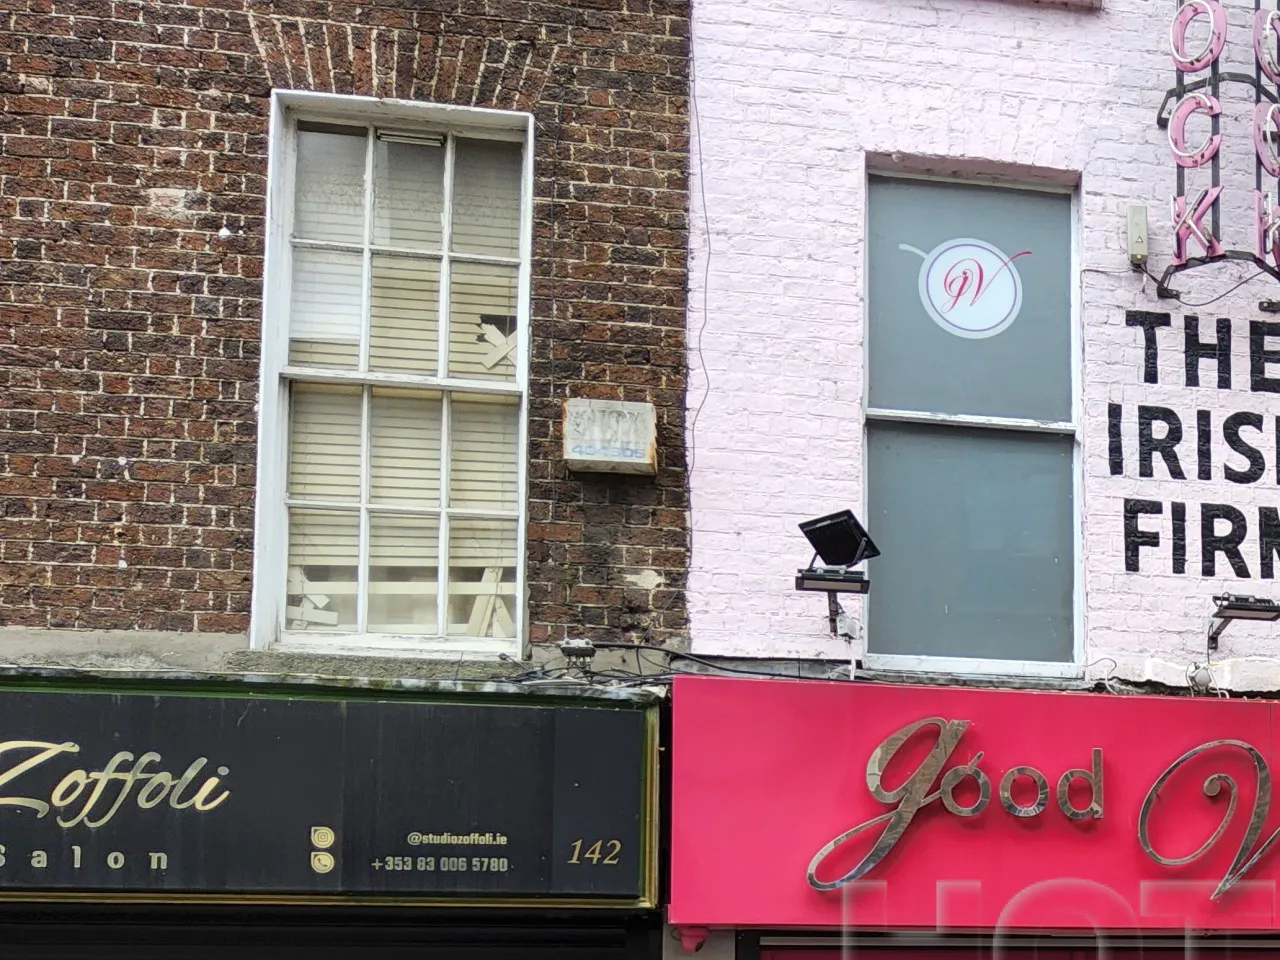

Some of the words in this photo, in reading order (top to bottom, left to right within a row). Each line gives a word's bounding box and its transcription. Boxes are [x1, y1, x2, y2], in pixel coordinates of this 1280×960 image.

[0, 740, 230, 828] Zoffoli
[407, 831, 508, 846] @studiozoffoli.ie
[567, 838, 622, 865] 142
[371, 855, 412, 872] +353
[417, 856, 435, 872] 83
[439, 856, 467, 872] 006
[471, 857, 508, 872] 5780
